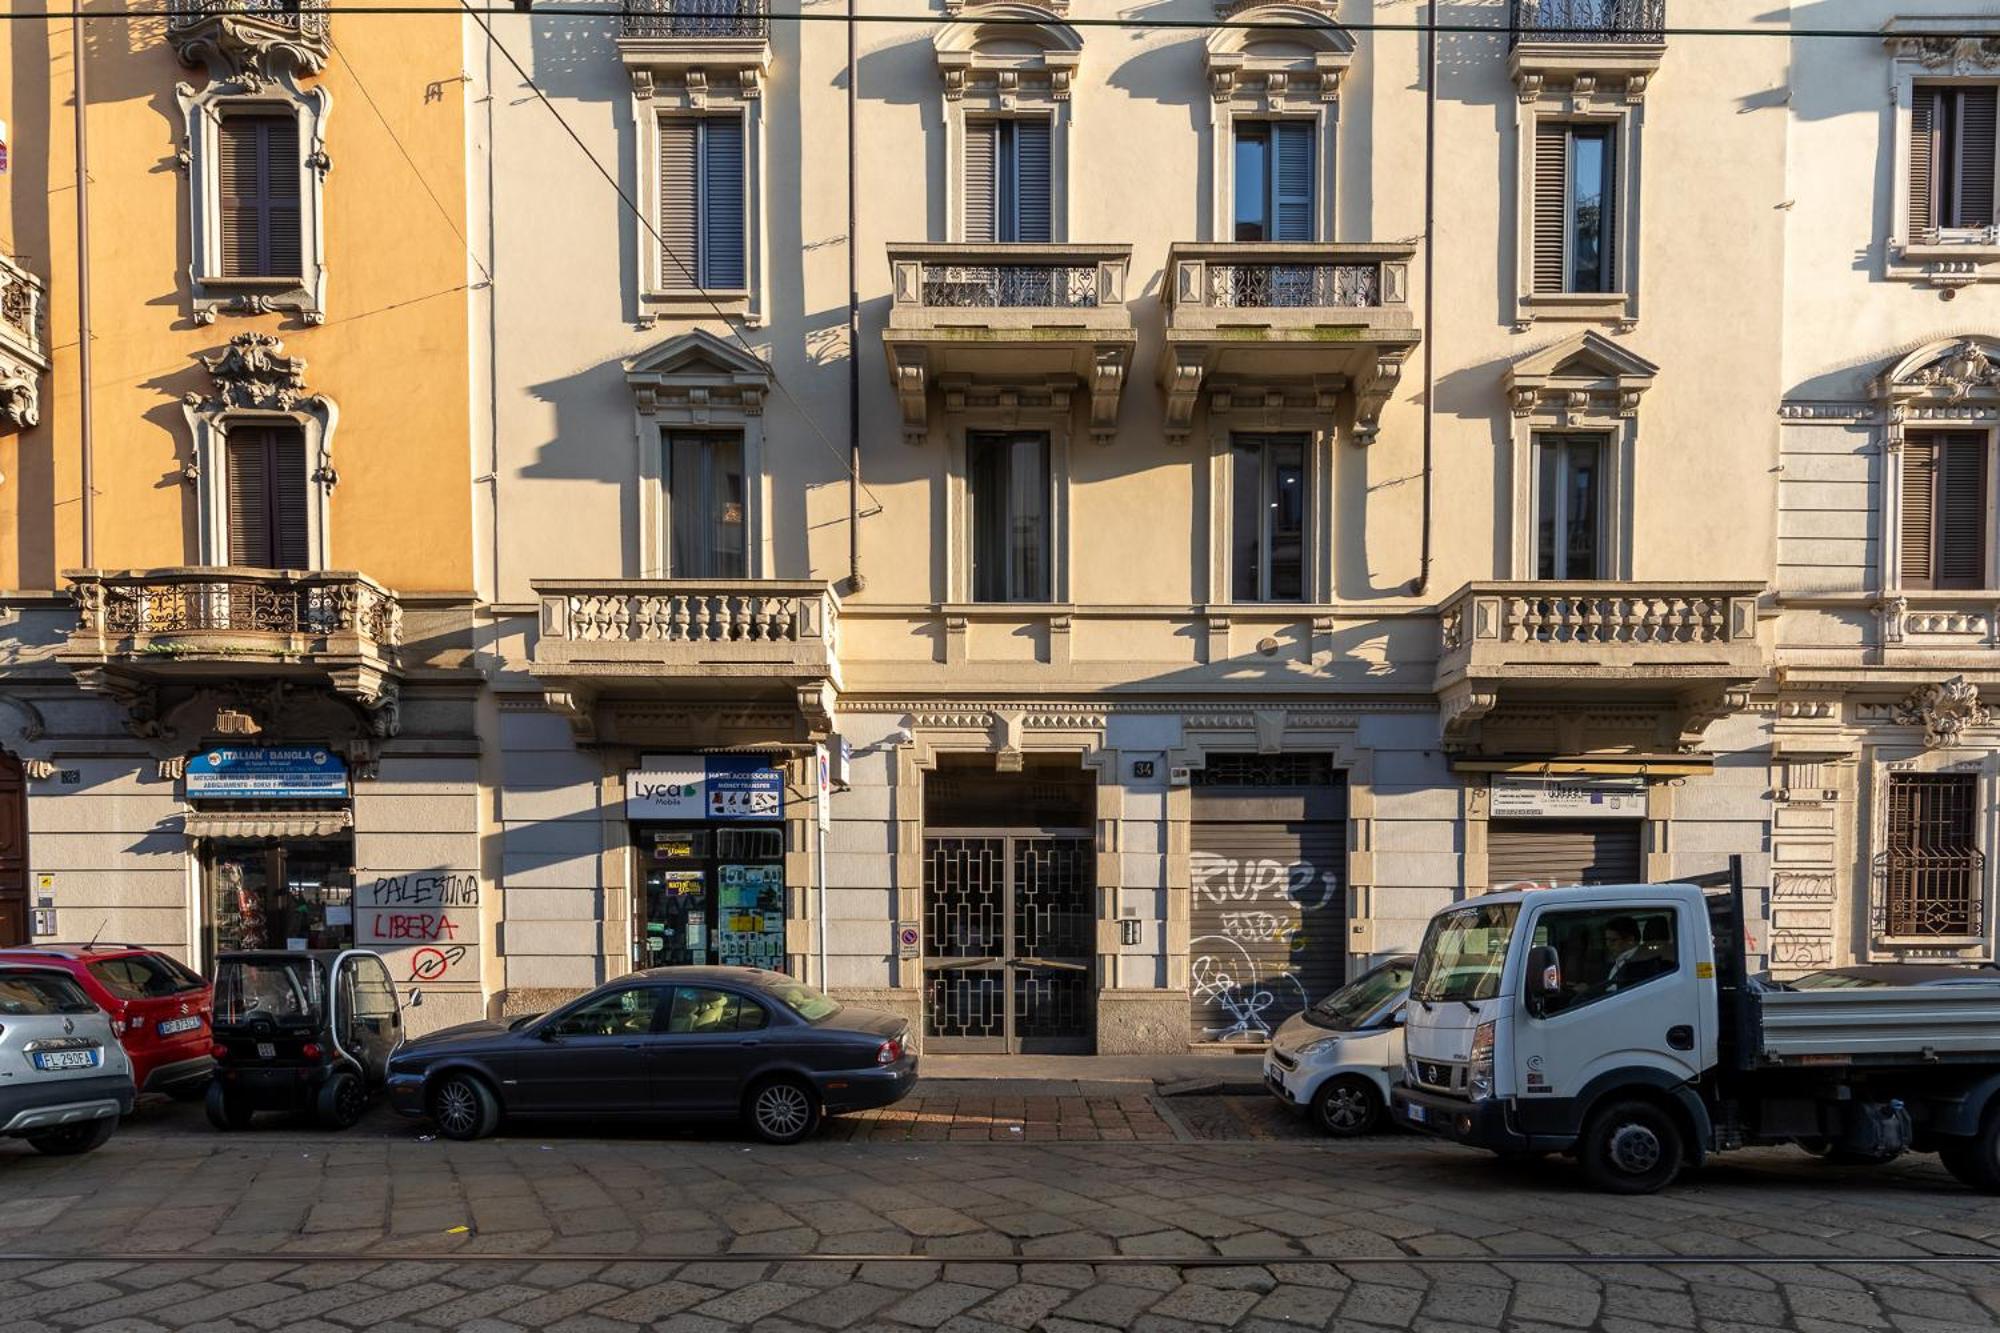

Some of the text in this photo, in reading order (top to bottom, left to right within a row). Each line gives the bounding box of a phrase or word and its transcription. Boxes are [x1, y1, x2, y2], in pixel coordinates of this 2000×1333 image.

[223, 751, 312, 760] ITALIAN BANGLA
[1136, 762, 1152, 776] 34
[635, 781, 681, 800] Lyca
[373, 875, 479, 905] PALESTINA
[374, 914, 459, 940] LIBERA
